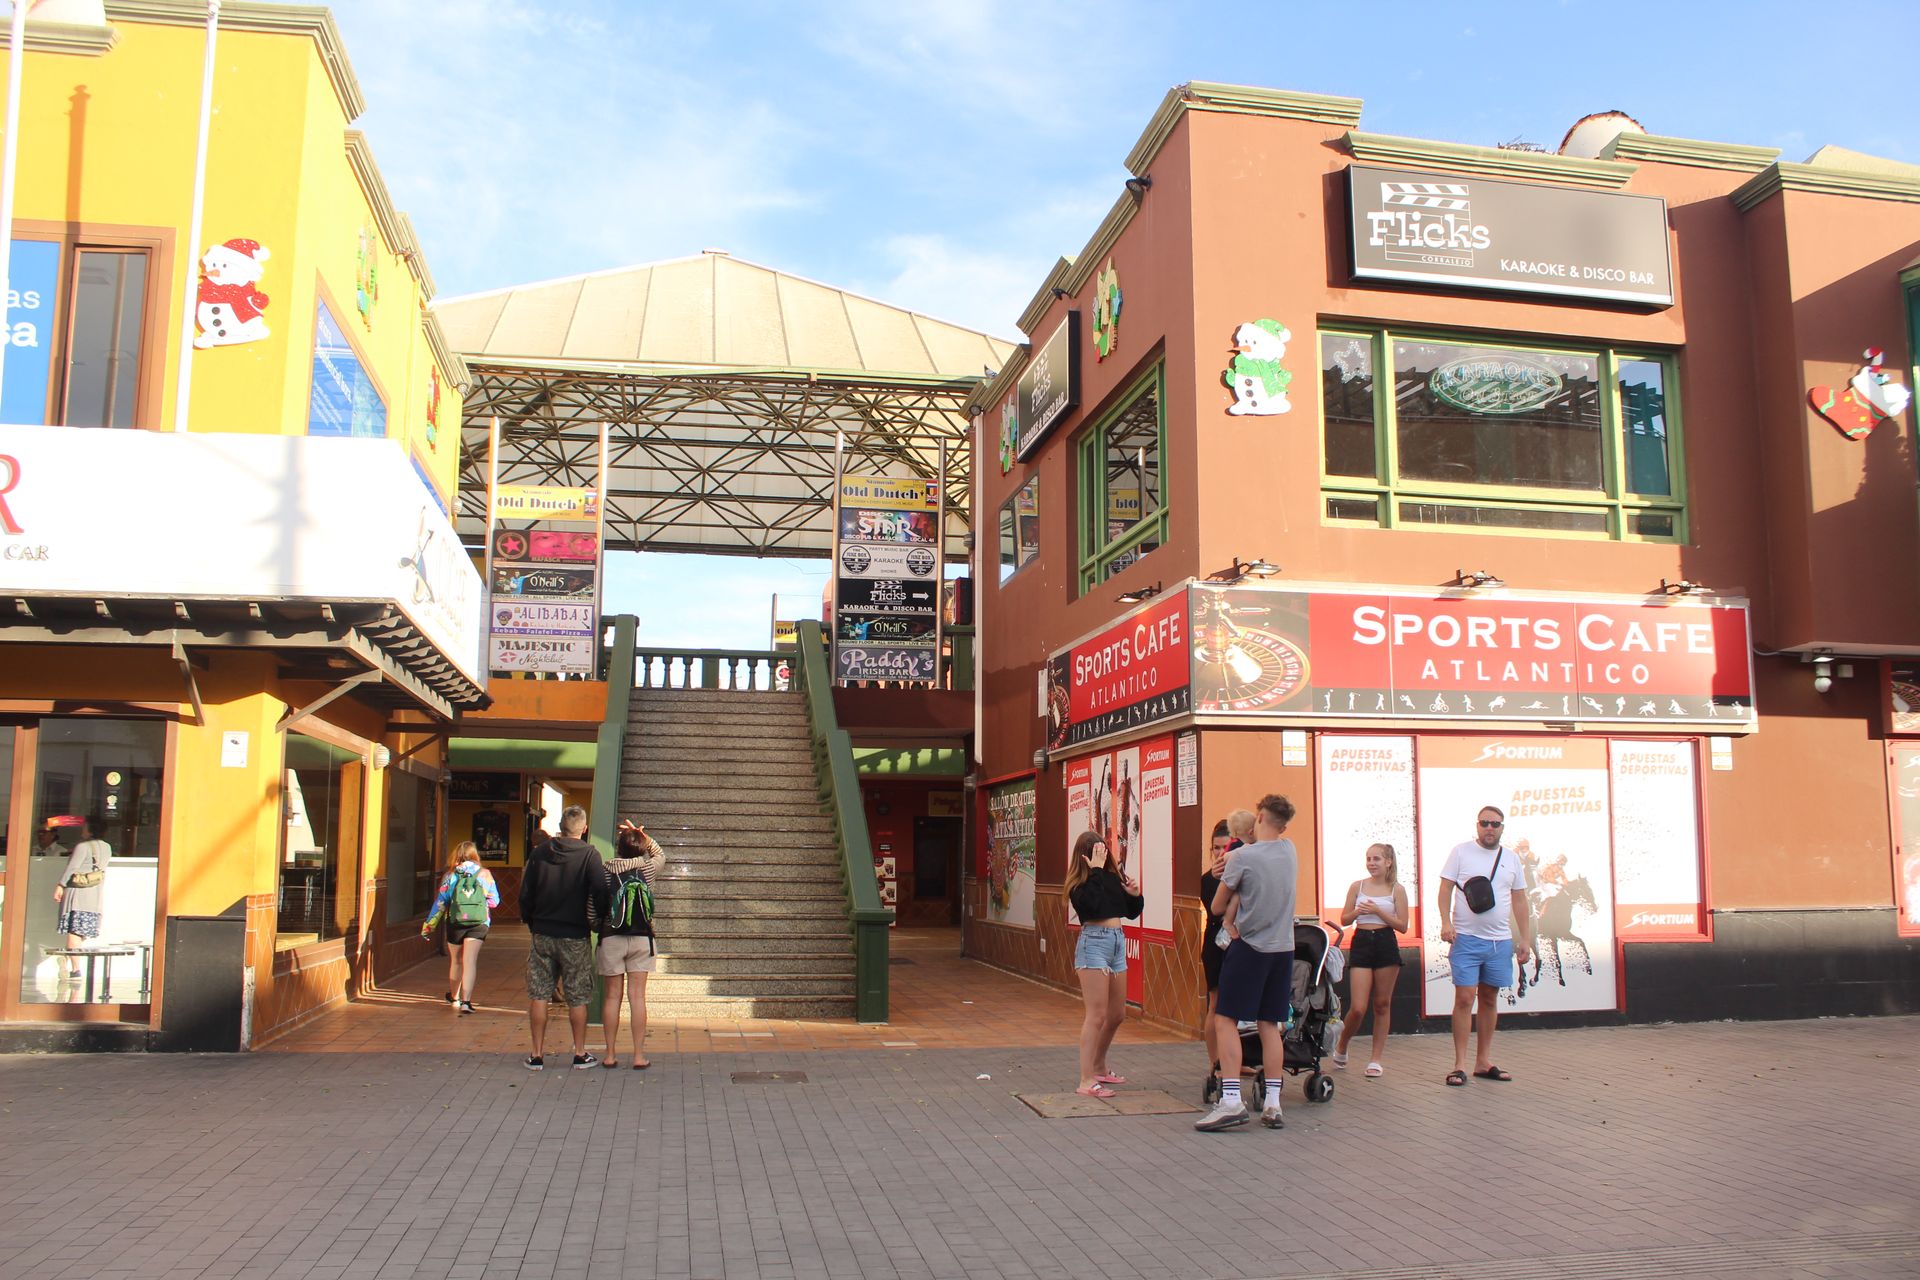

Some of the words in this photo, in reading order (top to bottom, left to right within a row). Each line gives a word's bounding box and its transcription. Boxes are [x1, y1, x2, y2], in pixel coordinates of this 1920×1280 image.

[1367, 211, 1491, 249] Flicks
[1421, 255, 1472, 266] CORRALEJO
[1500, 259, 1566, 277] KARAOKE
[1569, 265, 1581, 279] &
[1583, 266, 1626, 283] DISCO
[1629, 270, 1655, 286] BAR
[1440, 361, 1552, 390] KARAOKE
[843, 486, 868, 497] Old
[874, 487, 918, 499] Dutch
[497, 497, 524, 507] Old
[530, 498, 576, 510] Dutch
[858, 516, 921, 536] STAR
[4, 544, 49, 561] CAR
[870, 590, 907, 601] Flicks
[1352, 606, 1561, 650] SPORTS
[1577, 614, 1713, 655] CAFE
[498, 640, 576, 652] MAJESTIC
[1075, 638, 1131, 686] SPORTS
[1134, 612, 1181, 661] CAFE
[519, 652, 565, 669] Nightclub
[860, 667, 885, 676] IRISH
[1421, 660, 1650, 686] ATLANTICO
[1090, 667, 1157, 709] ATLANTICO
[1144, 749, 1170, 767] SPORTIUM
[1331, 749, 1393, 760] APUESTAS
[1471, 742, 1563, 763] SPORTIUM
[1621, 753, 1676, 764] APUESTAS
[1330, 761, 1406, 772] DEPORTIVAS
[1620, 764, 1688, 776] DEPORTIVAS
[1144, 775, 1165, 791] APUESTAS
[1144, 785, 1170, 803] DEPORTIVAS
[1512, 787, 1586, 802] APUESTAS
[1509, 801, 1602, 817] DEPORTIVAS
[1624, 912, 1694, 929] SPORTIUM
